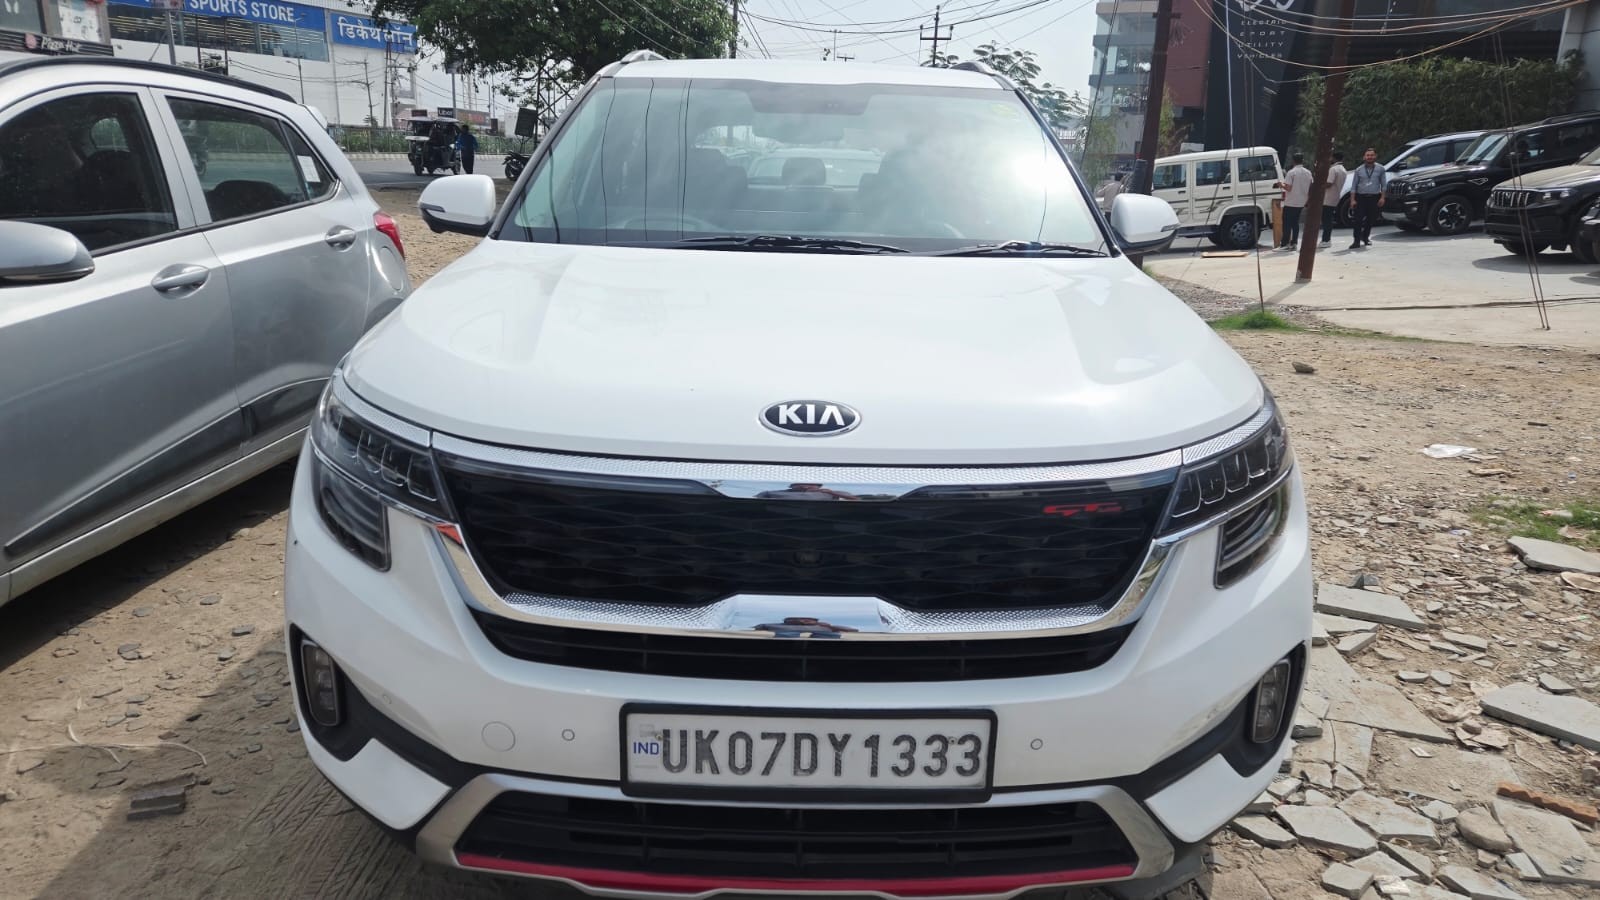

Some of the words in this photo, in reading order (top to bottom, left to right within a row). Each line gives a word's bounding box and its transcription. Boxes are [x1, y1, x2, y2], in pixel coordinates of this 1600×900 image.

[189, 0, 248, 16] SPORTS
[251, 3, 295, 22] STORE
[778, 404, 845, 425] KIA
[633, 742, 659, 755] IND
[663, 729, 982, 777] UK07DY1333
